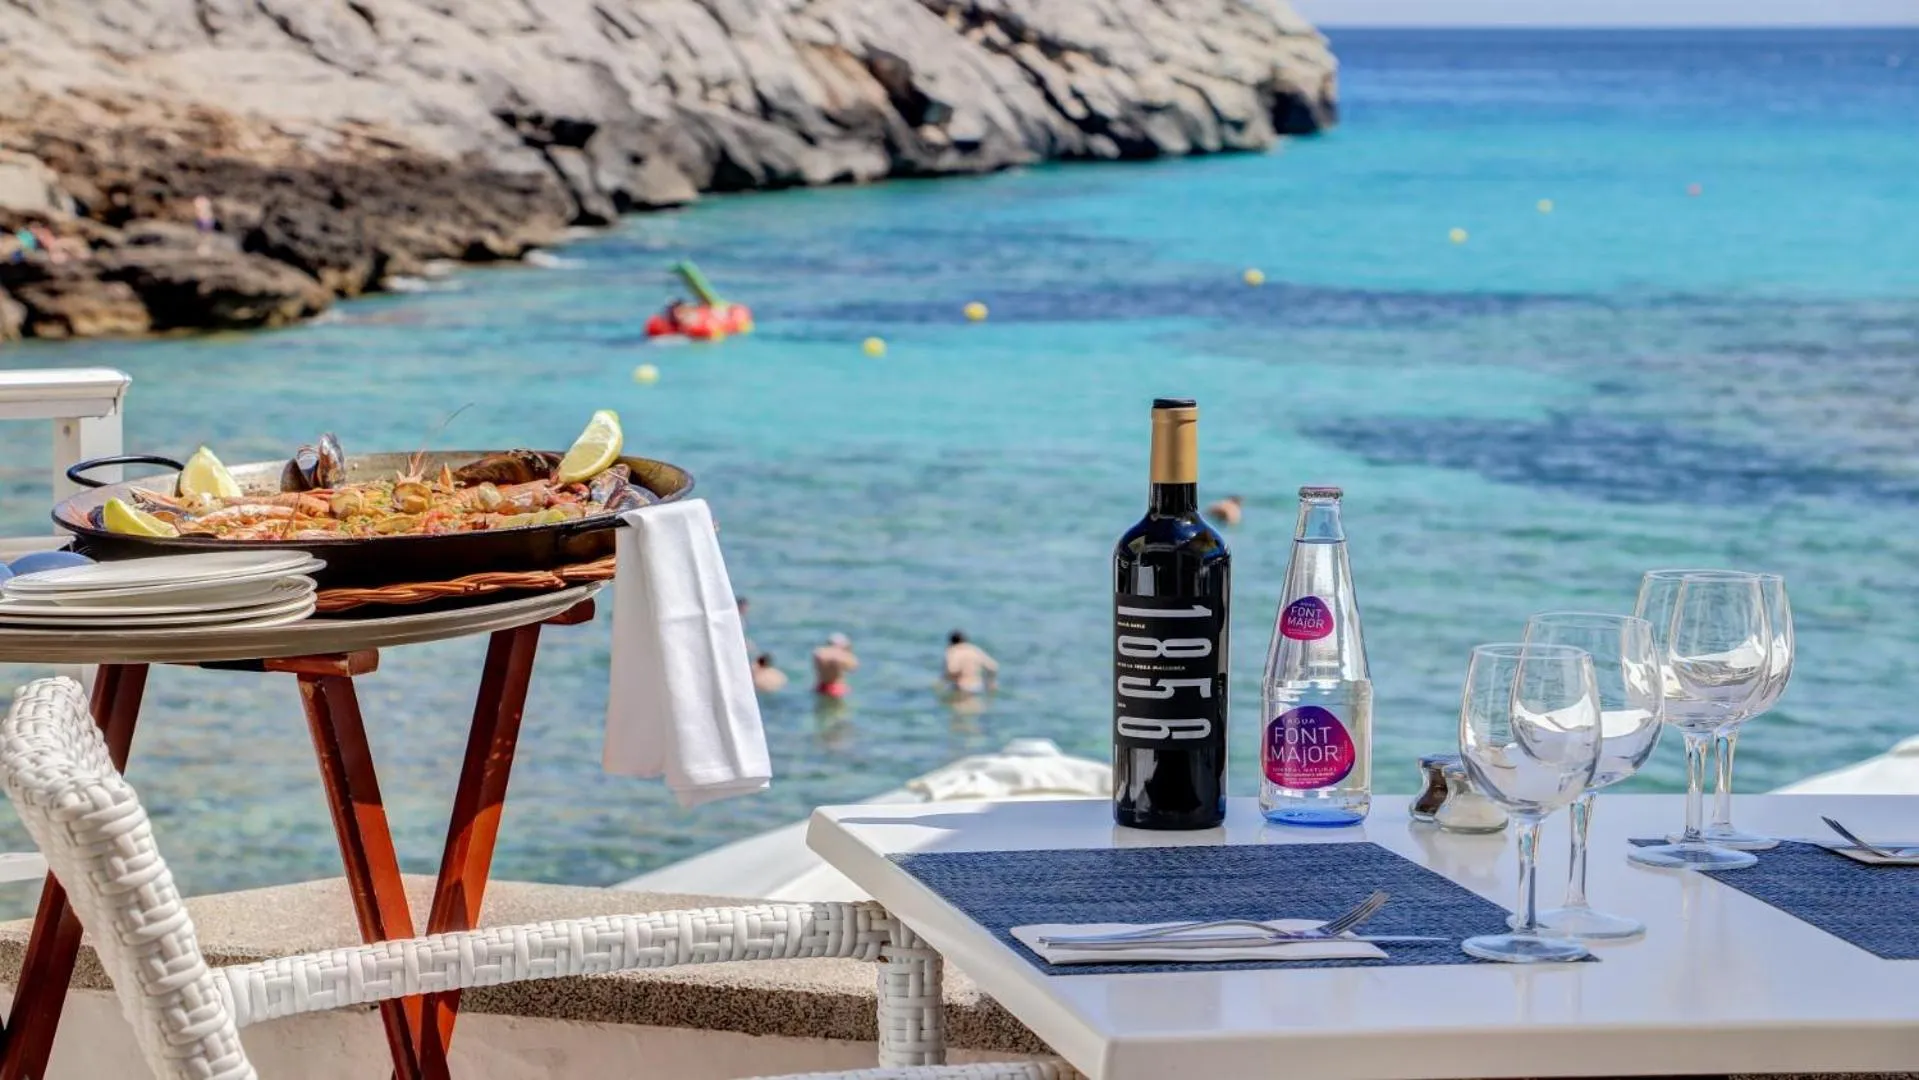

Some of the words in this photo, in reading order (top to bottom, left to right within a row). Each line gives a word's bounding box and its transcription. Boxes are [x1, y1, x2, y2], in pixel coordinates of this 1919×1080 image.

[1291, 606, 1322, 617] FONT
[1118, 605, 1212, 739] 1856
[1275, 726, 1332, 744] FONT
